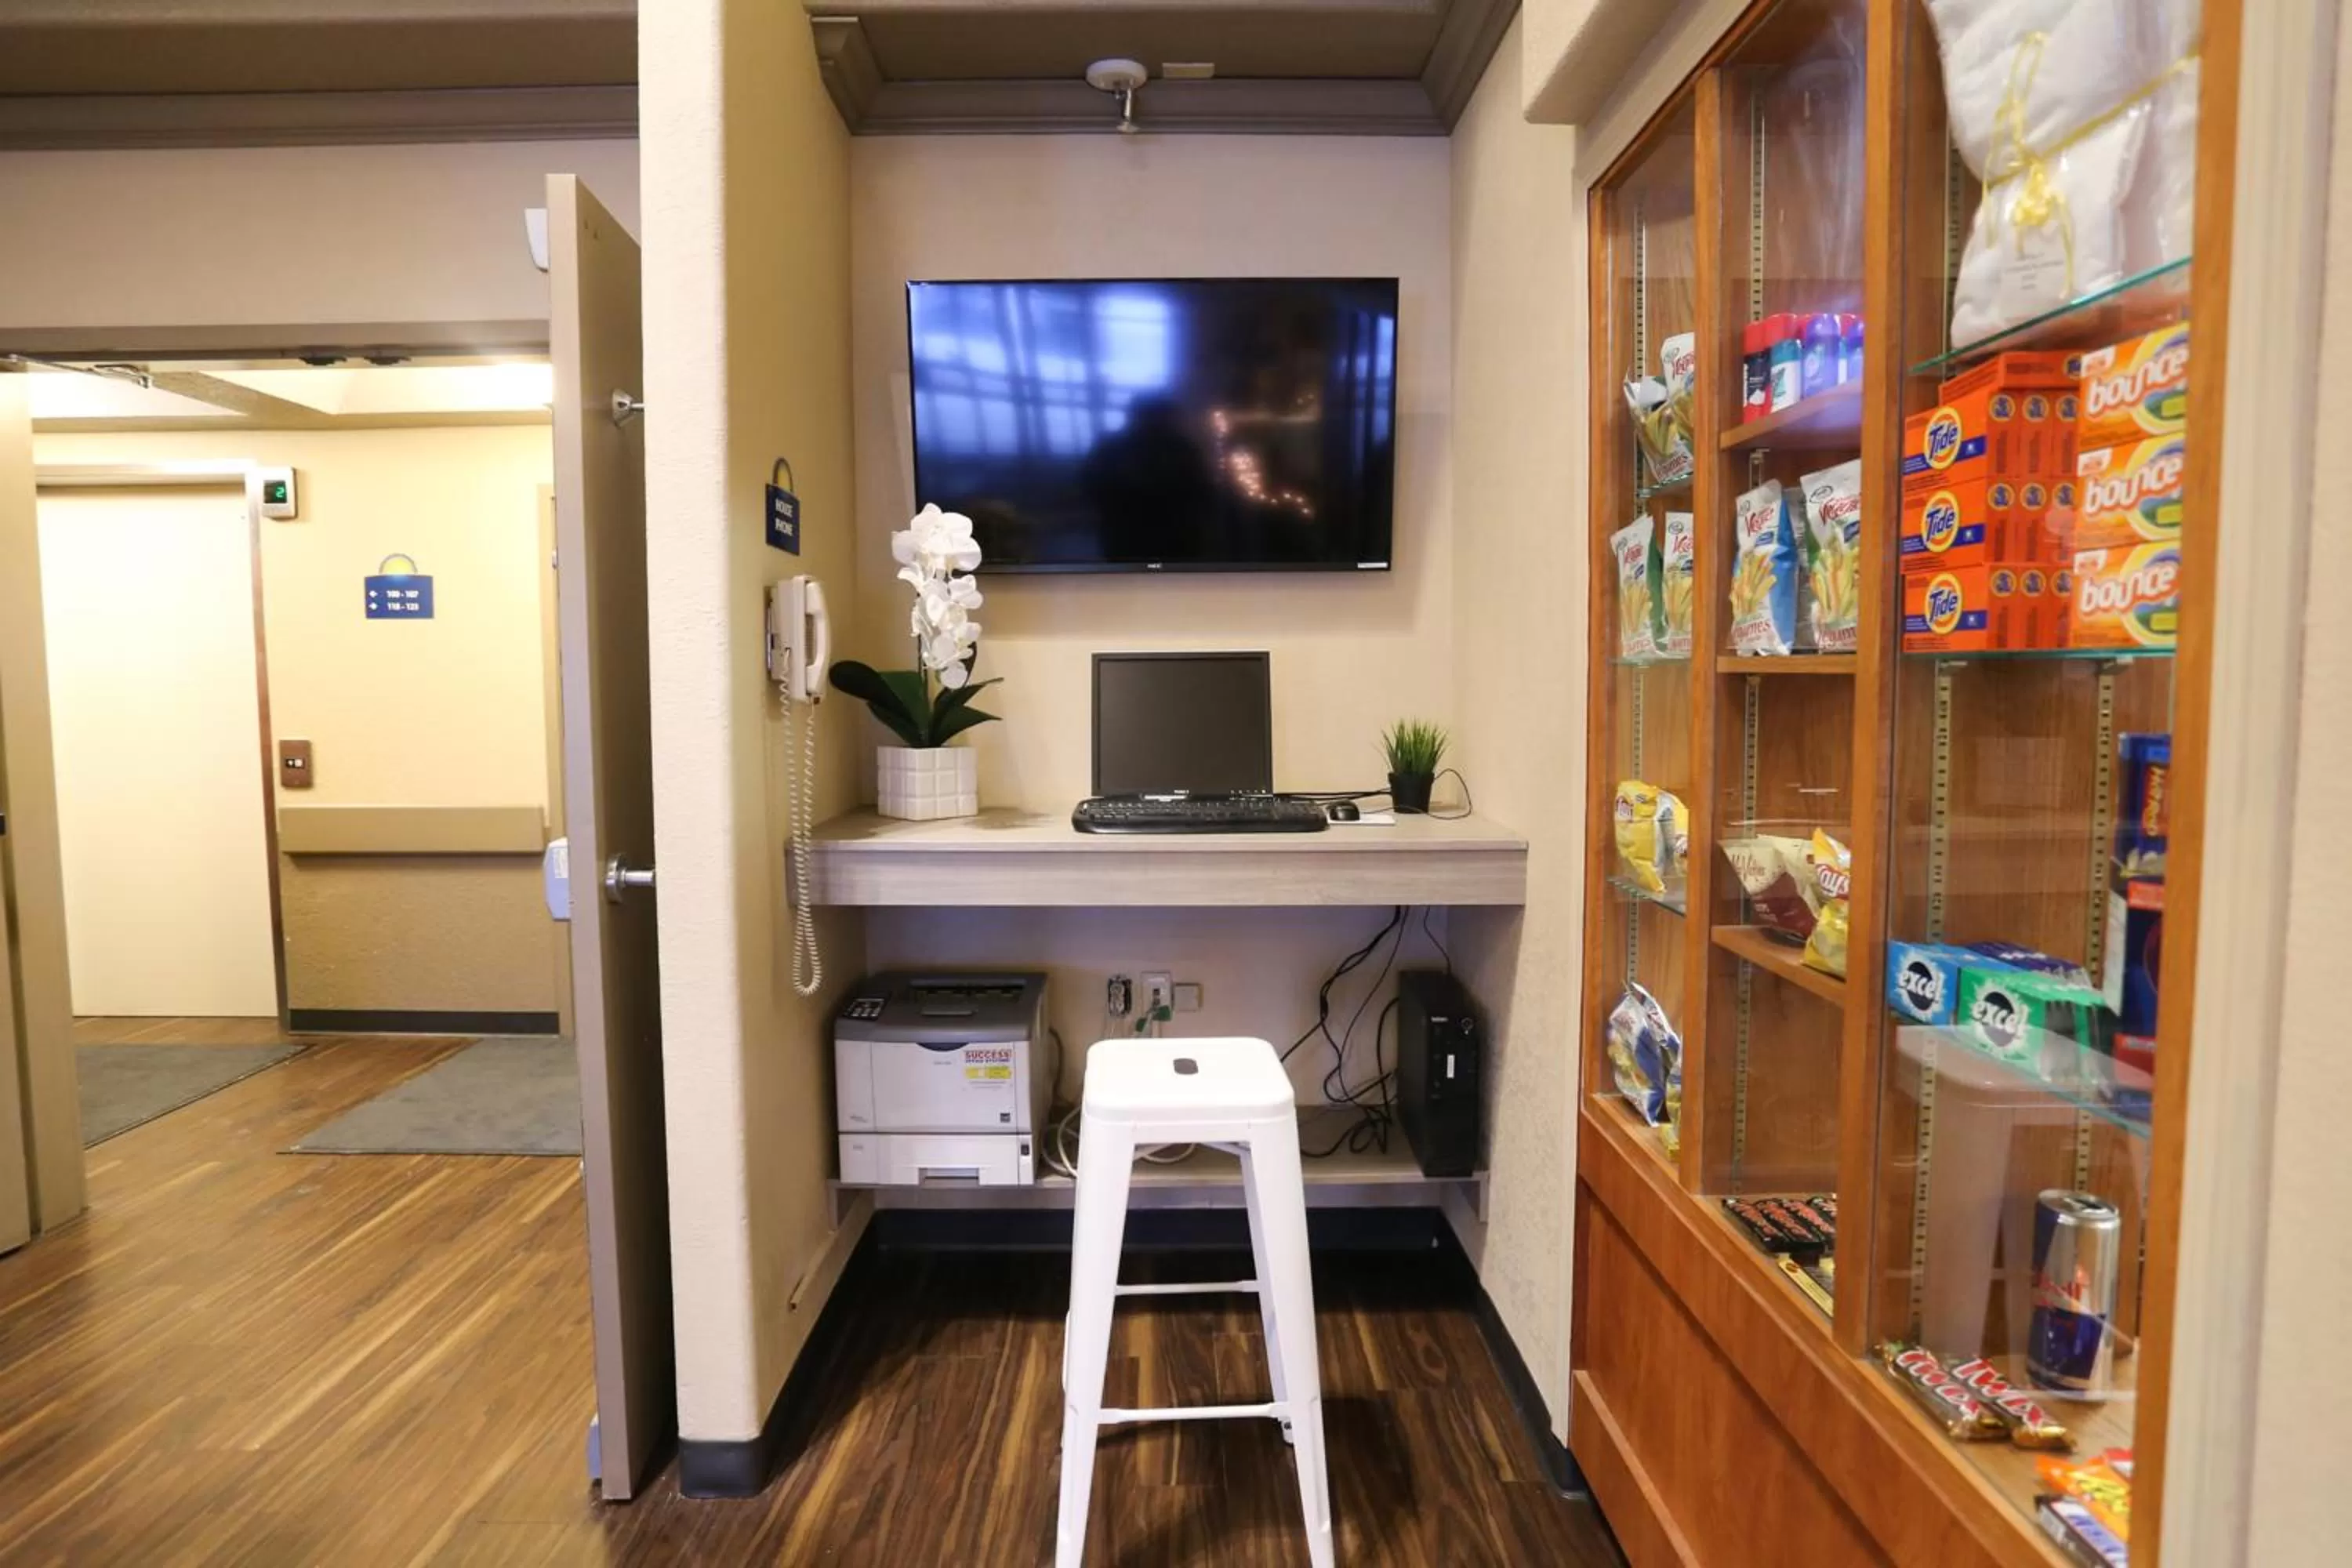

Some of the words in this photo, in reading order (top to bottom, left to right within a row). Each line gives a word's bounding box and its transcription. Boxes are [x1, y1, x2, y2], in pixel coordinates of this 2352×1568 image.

[2088, 348, 2189, 414] bounce
[1929, 423, 1958, 461] Tide
[2084, 456, 2183, 514] bounce
[1926, 508, 1955, 543] Tide
[2081, 561, 2179, 613] bounce
[1929, 589, 1958, 623] Tide
[1897, 970, 1944, 1004] excel
[1971, 1000, 2030, 1037] excel
